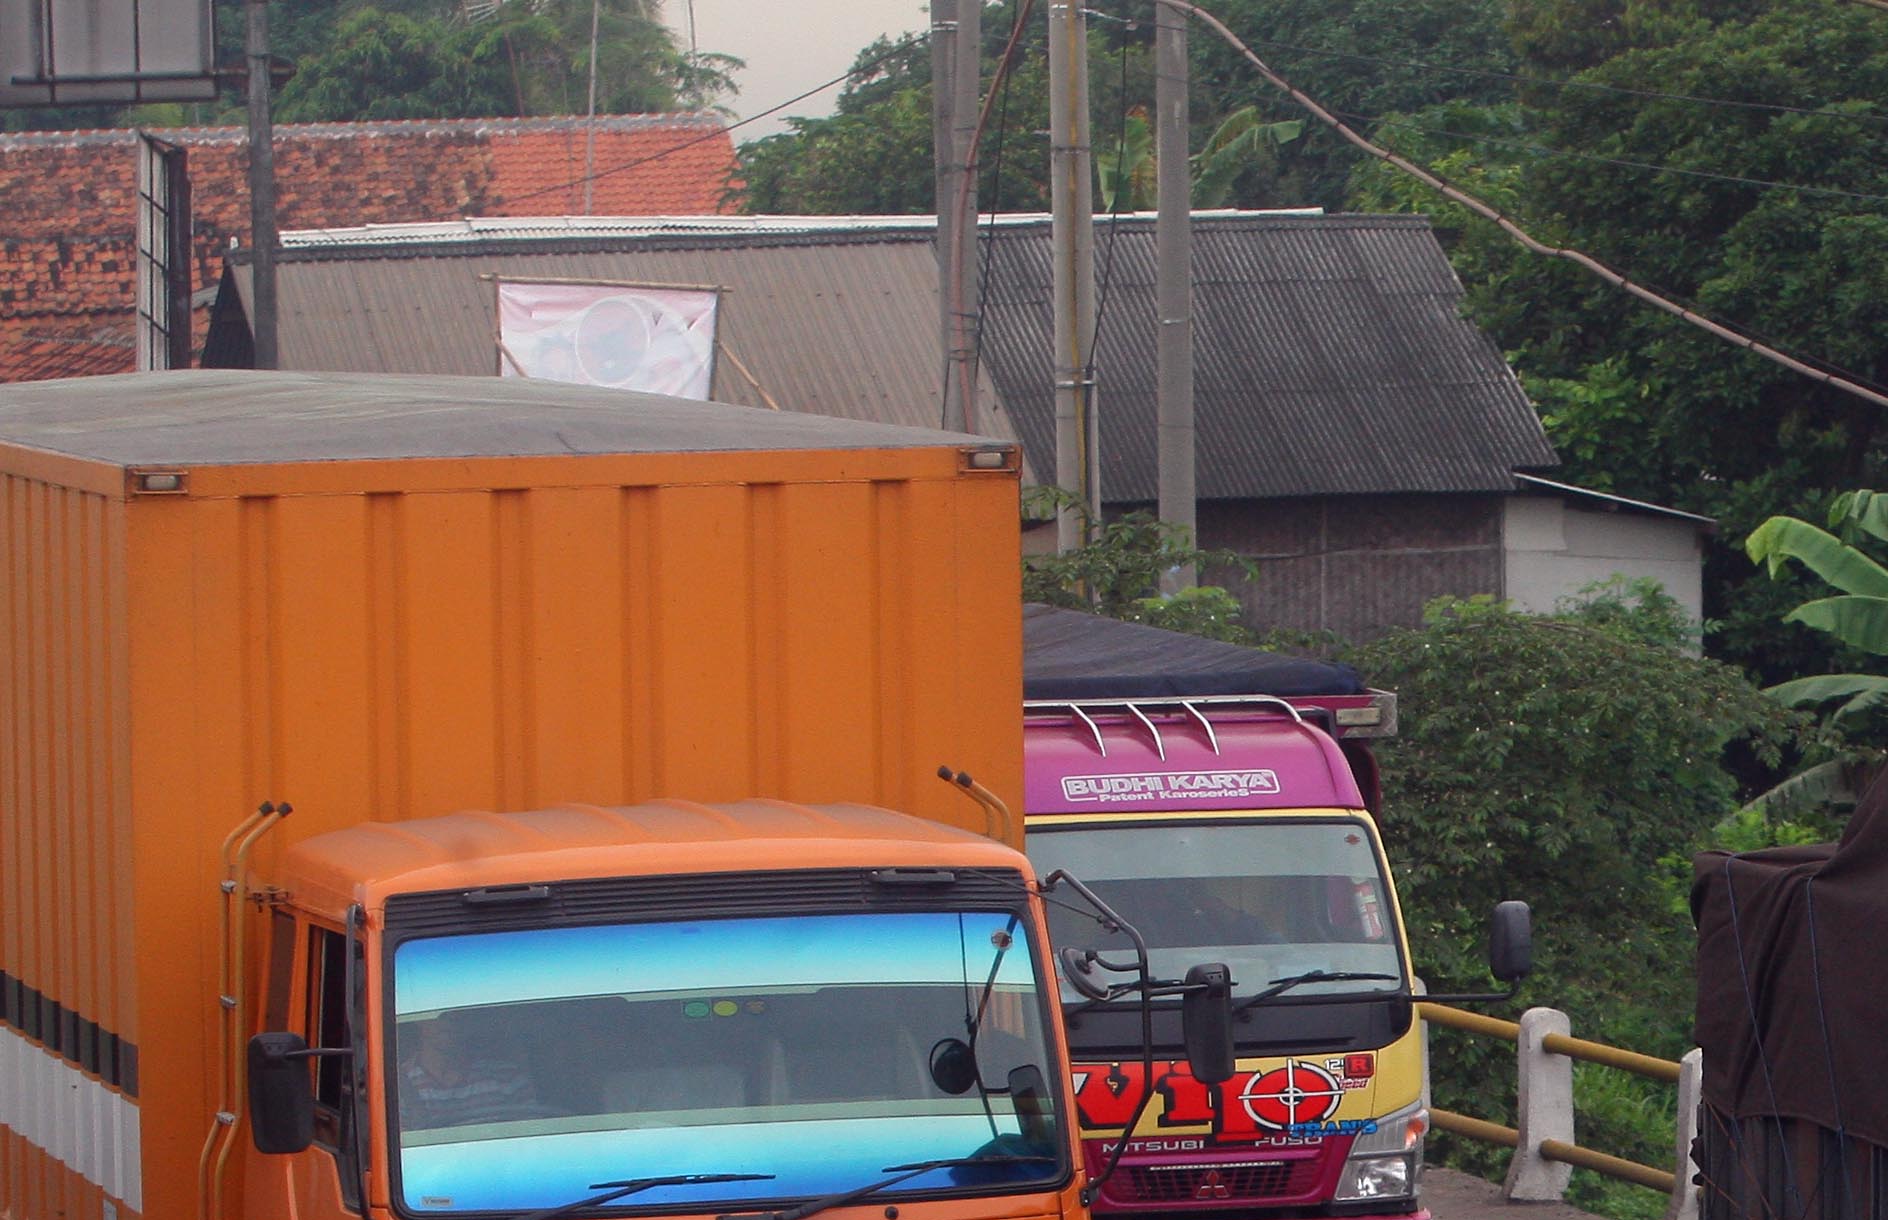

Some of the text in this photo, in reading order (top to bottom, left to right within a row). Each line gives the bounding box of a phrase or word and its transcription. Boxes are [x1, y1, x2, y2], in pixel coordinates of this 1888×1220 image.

[1066, 773, 1272, 796] BUDHI KARYA
[1099, 791, 1154, 802] Patent
